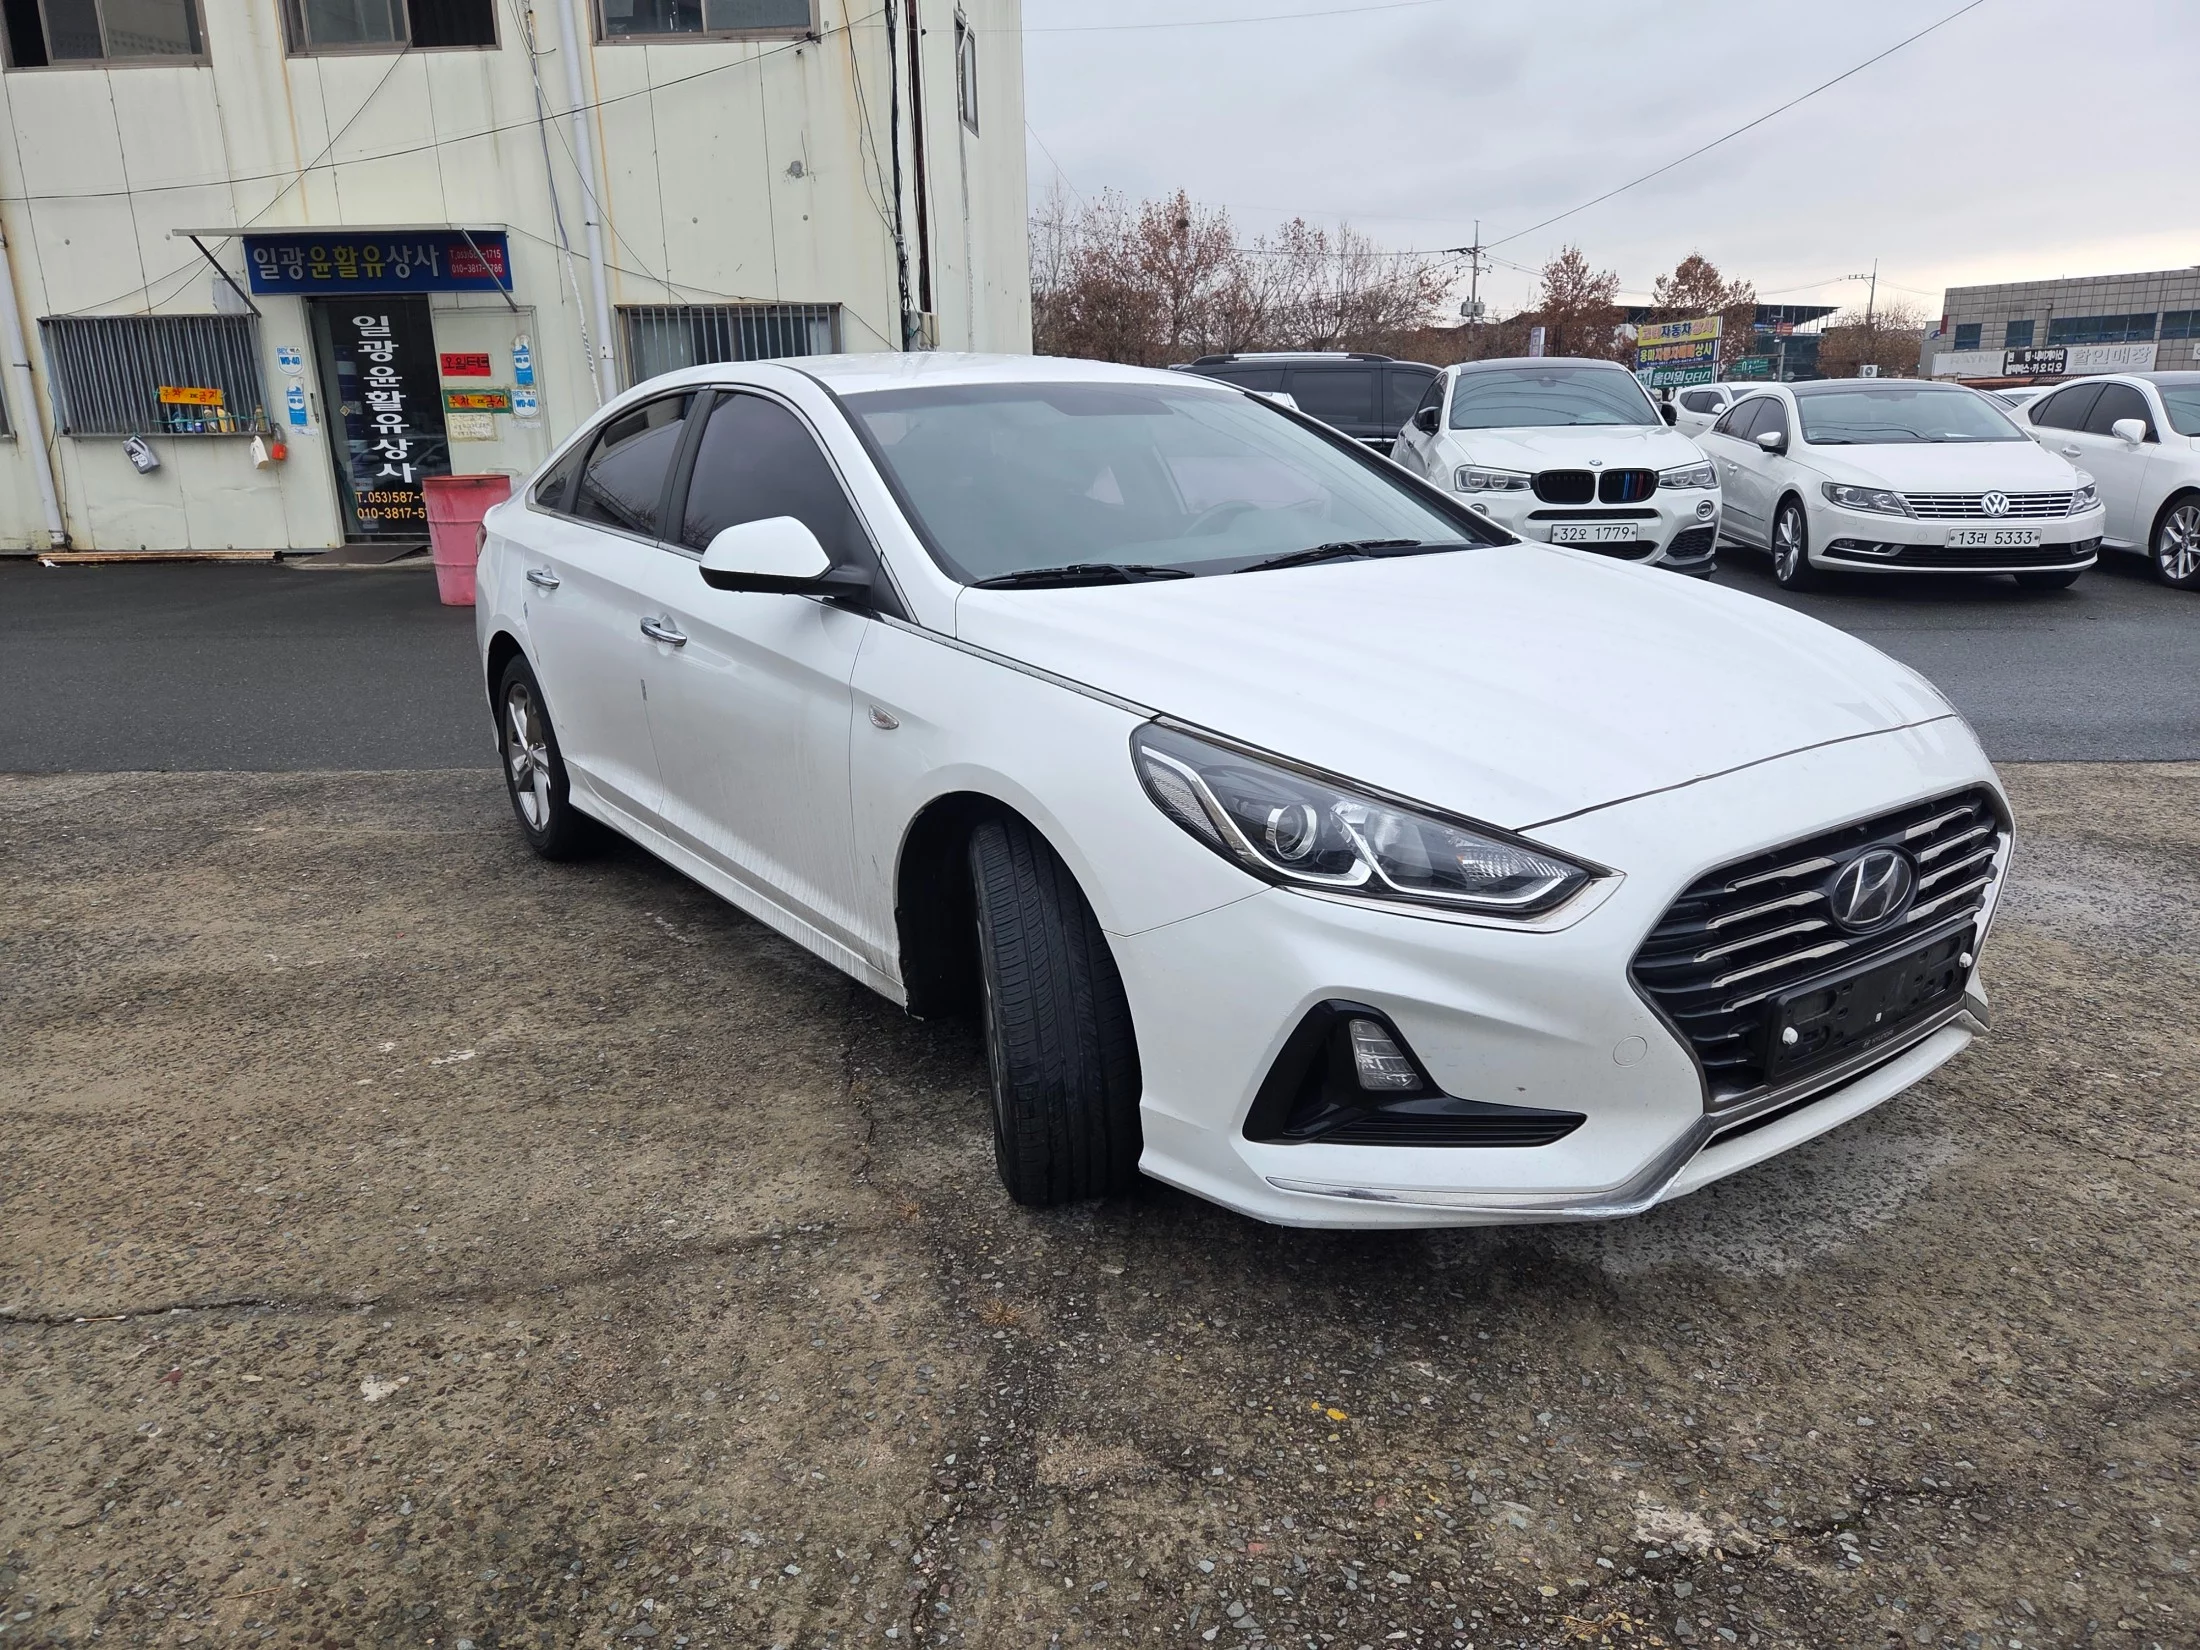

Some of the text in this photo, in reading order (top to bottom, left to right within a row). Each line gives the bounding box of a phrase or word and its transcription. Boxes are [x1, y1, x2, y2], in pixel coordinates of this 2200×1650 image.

[253, 244, 439, 279] 일광윤활유상사
[451, 263, 503, 273] 010-3817-786
[280, 356, 300, 365] WD-40
[2073, 346, 2152, 366] 할인매장
[352, 315, 417, 484] 일광윤활유상사
[515, 398, 536, 408] WD-40
[357, 507, 428, 519] 010-3817-5
[1560, 526, 1630, 540] 32오 1779
[1959, 531, 2033, 545] 13러 5333
